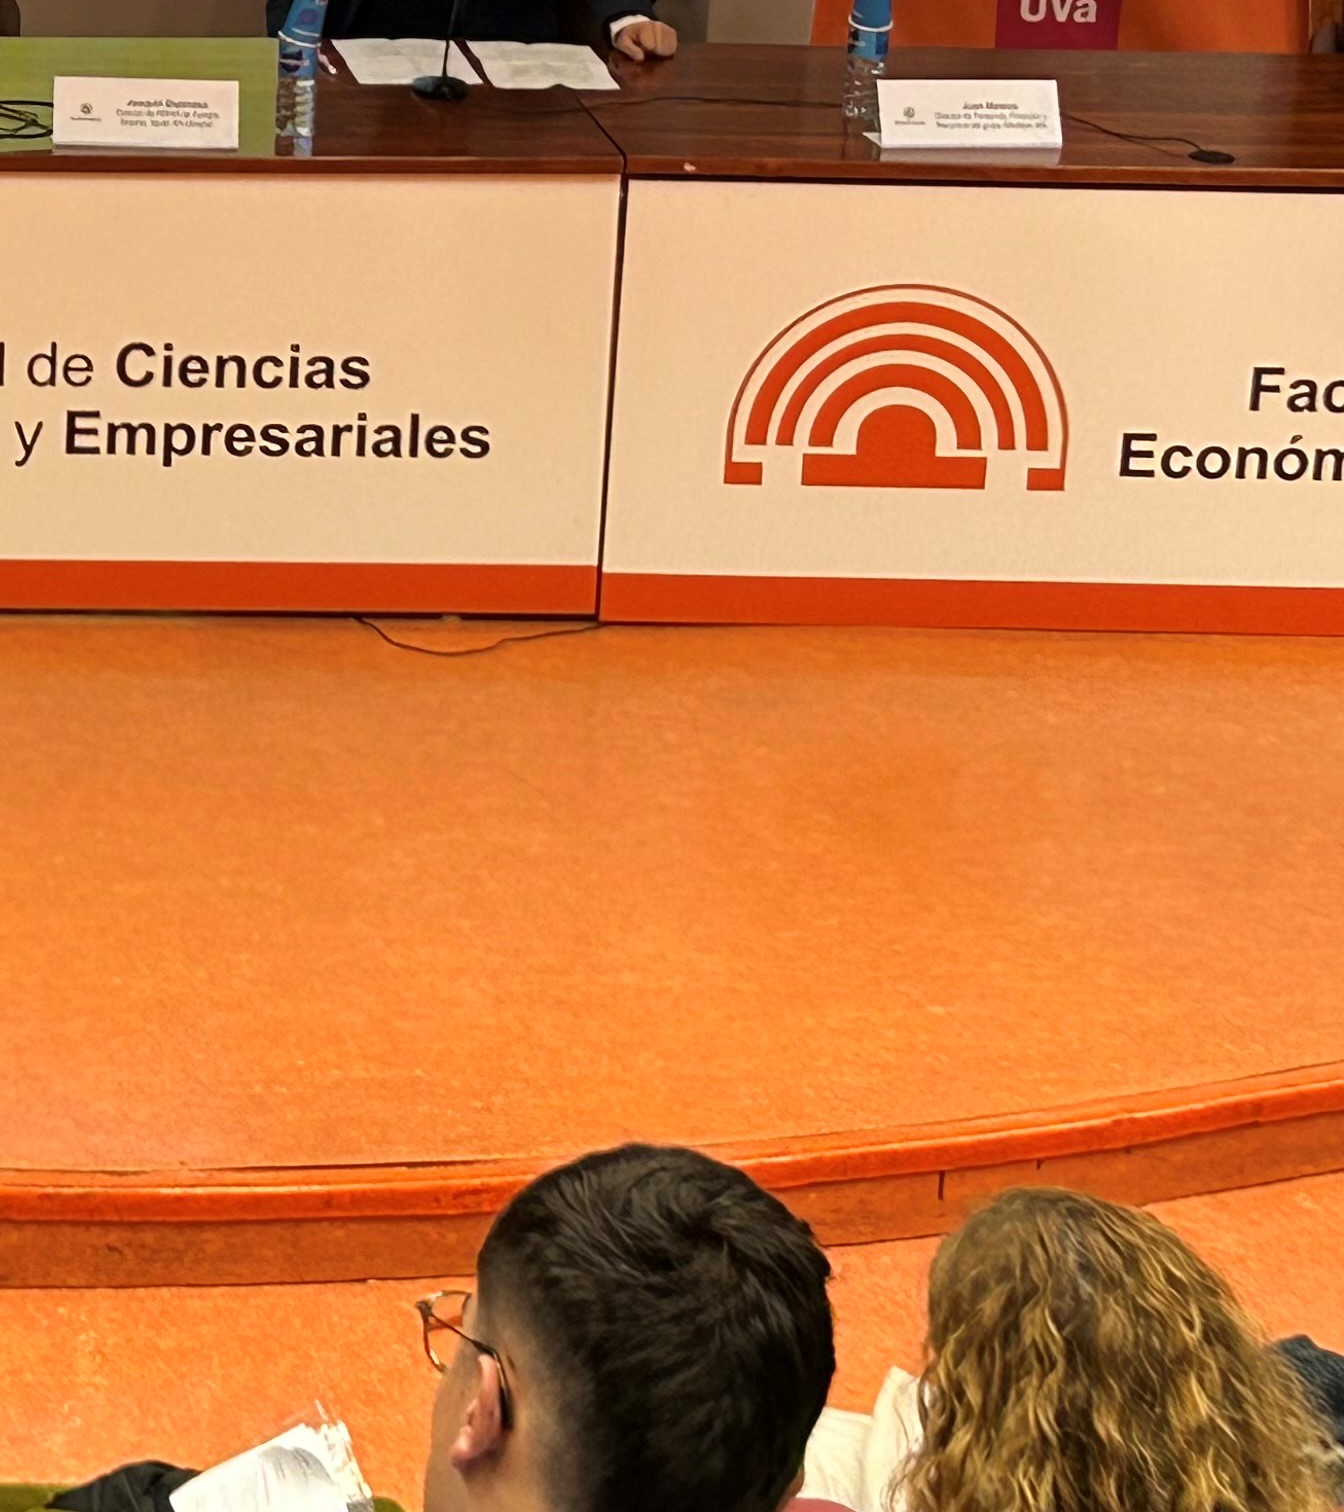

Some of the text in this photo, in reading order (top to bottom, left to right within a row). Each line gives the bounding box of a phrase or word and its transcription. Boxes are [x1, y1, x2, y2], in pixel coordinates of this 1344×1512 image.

[26, 341, 94, 388] de
[116, 342, 371, 390] Ciencias
[1249, 366, 1344, 413] Fac
[14, 420, 44, 467] y
[65, 409, 490, 468] Empresariales
[1119, 432, 1344, 481] Económ
